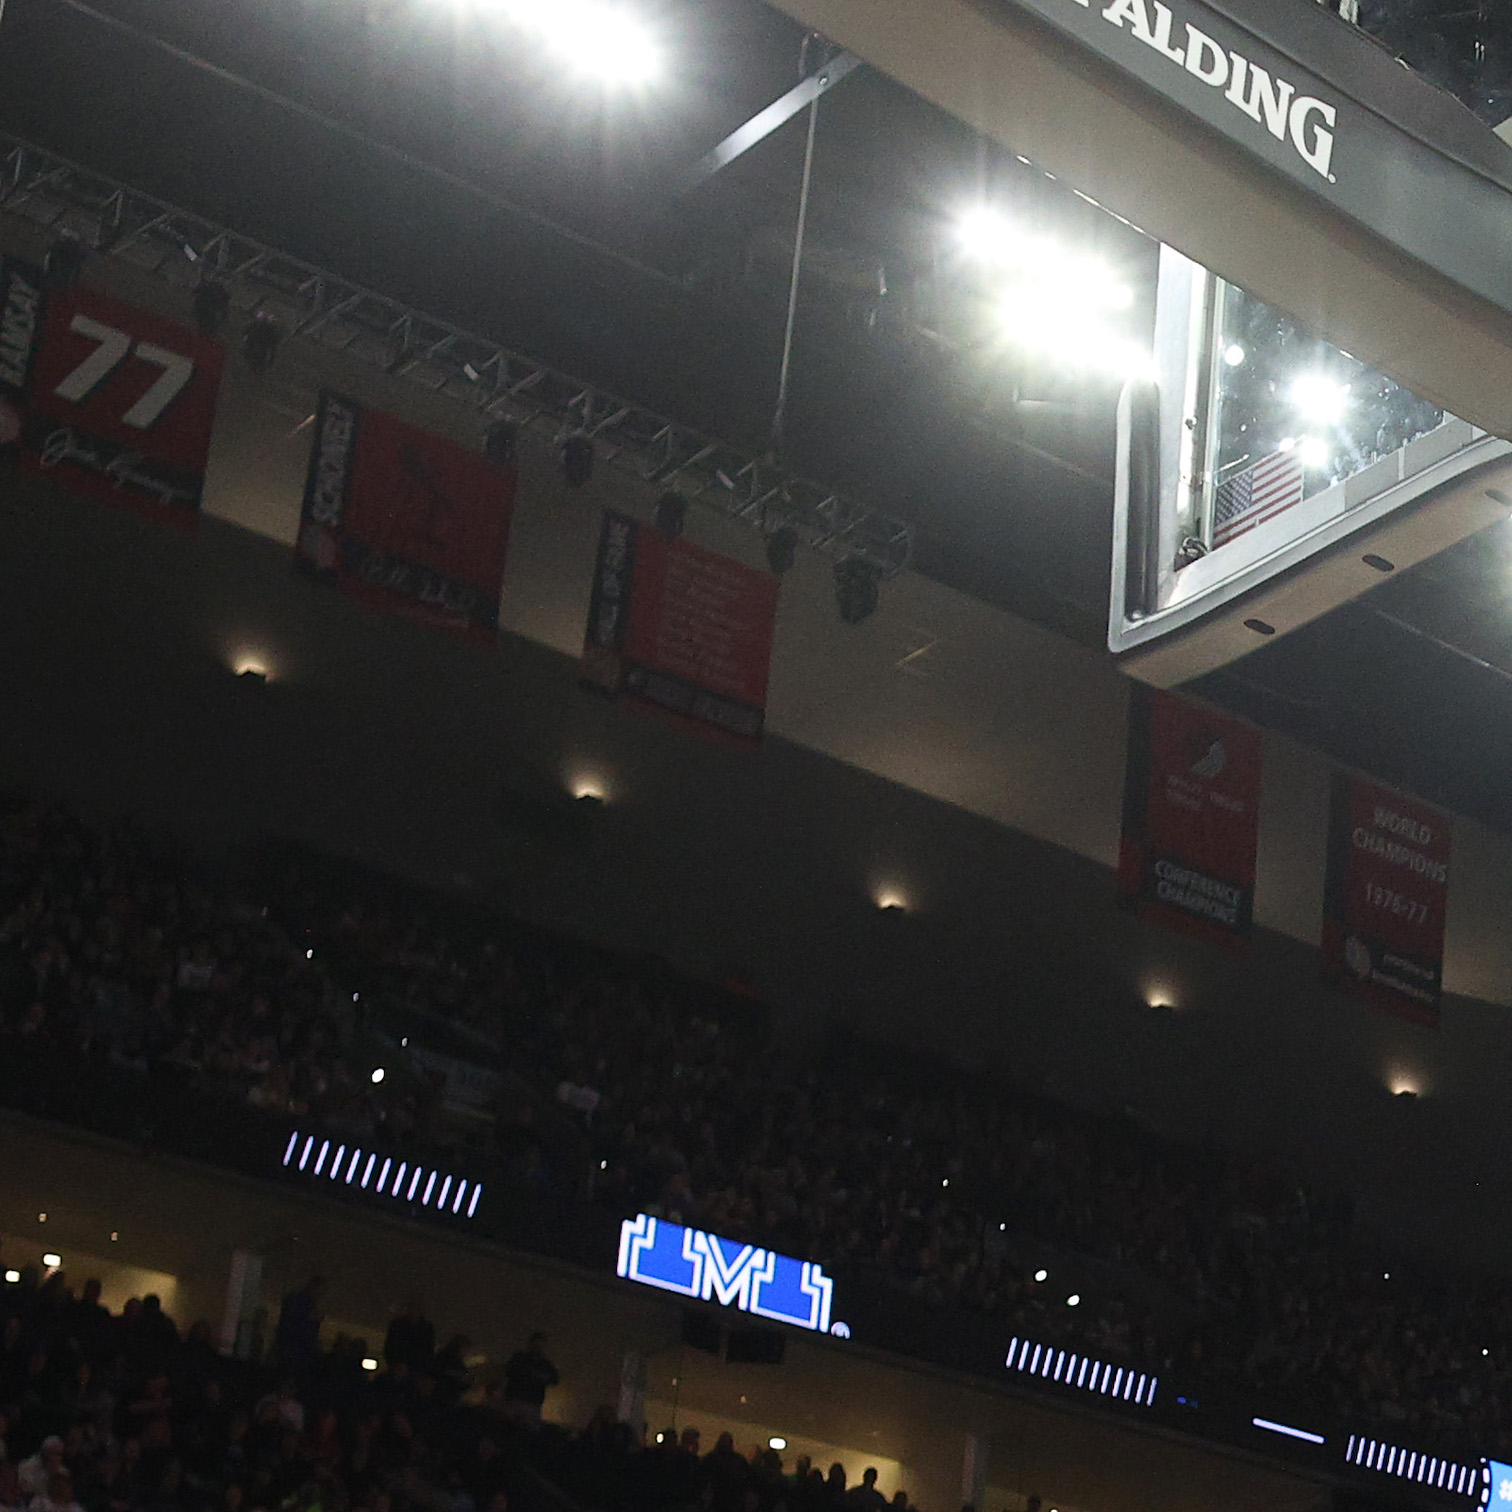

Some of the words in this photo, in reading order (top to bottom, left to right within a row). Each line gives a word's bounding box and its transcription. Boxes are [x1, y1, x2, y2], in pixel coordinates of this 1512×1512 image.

[1074, 0, 1337, 184] ALDING
[53, 313, 195, 431] 77
[1352, 827, 1447, 883] CHAMPIONS
[1372, 805, 1432, 846] WORLD
